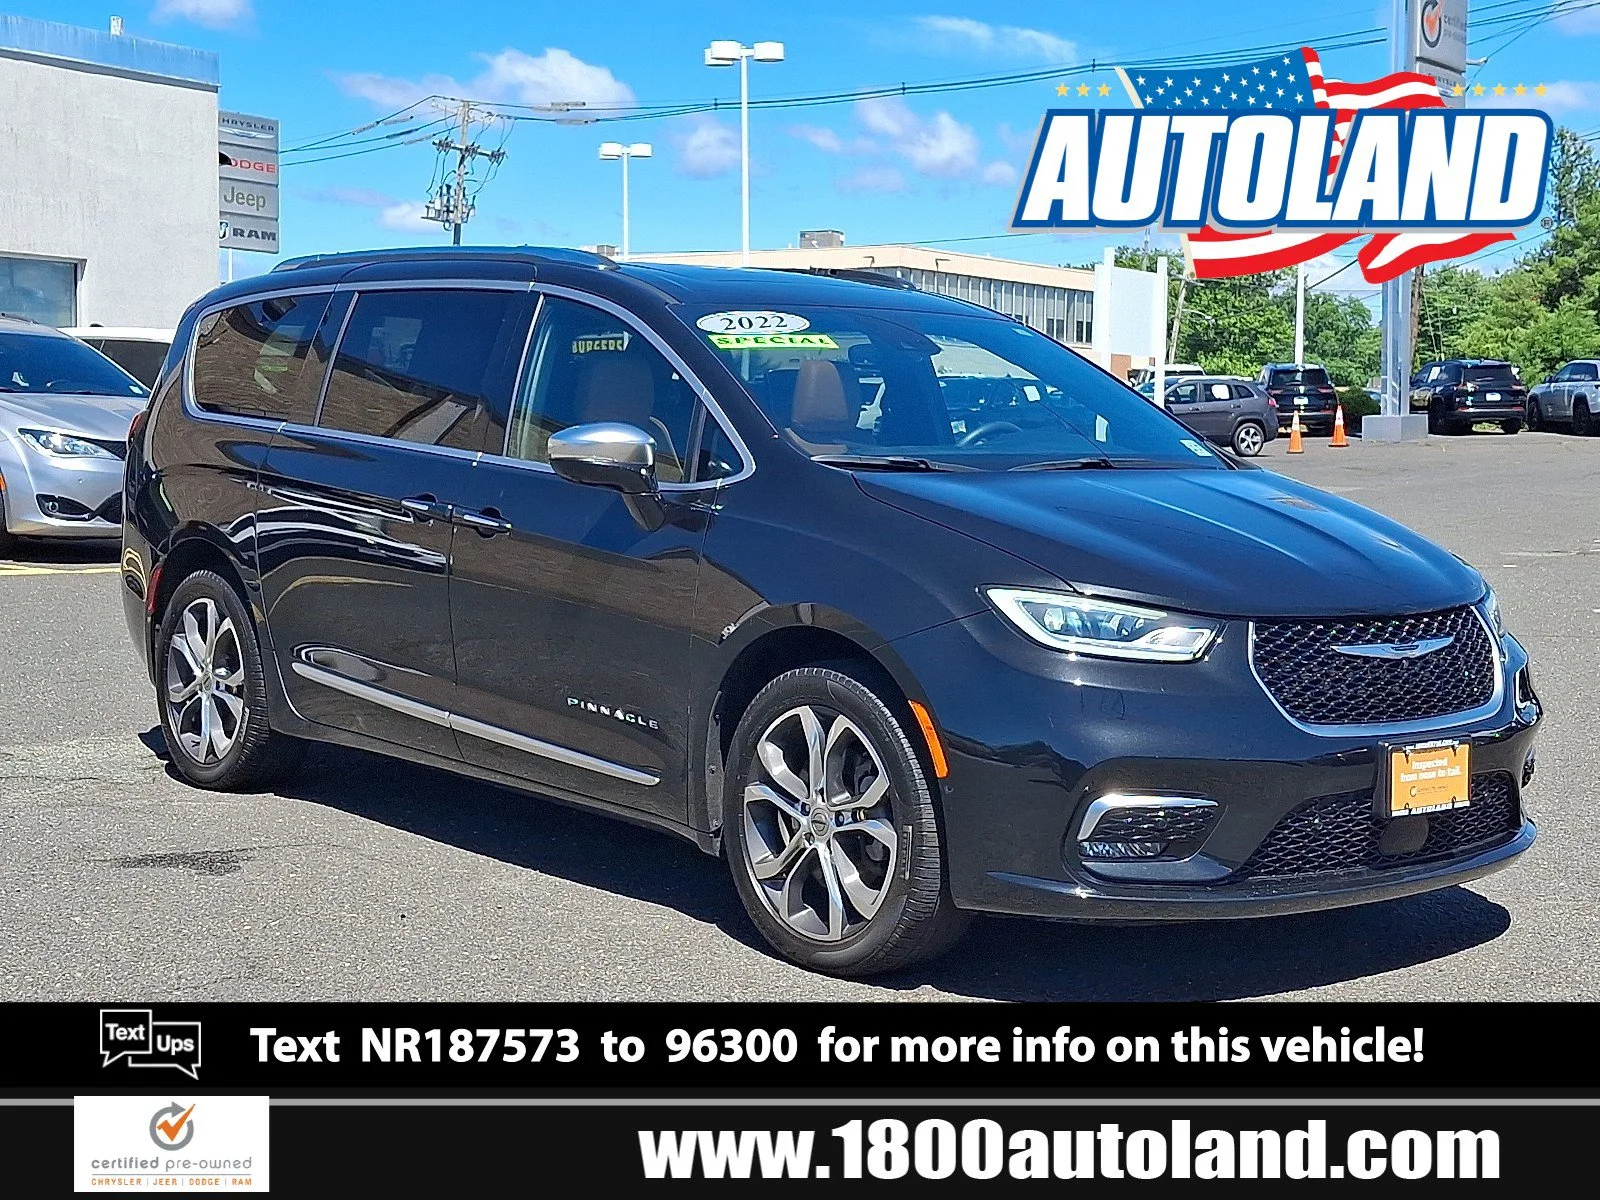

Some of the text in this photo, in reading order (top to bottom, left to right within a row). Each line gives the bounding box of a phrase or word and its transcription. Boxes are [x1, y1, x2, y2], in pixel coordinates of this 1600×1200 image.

[222, 117, 275, 132] HRYSLER
[229, 156, 276, 174] ODGE
[223, 186, 267, 212] Jeep
[232, 226, 277, 242] RAM
[719, 315, 789, 331] 2022
[716, 335, 831, 346] SPECIAL
[566, 697, 660, 730] PINNACLE
